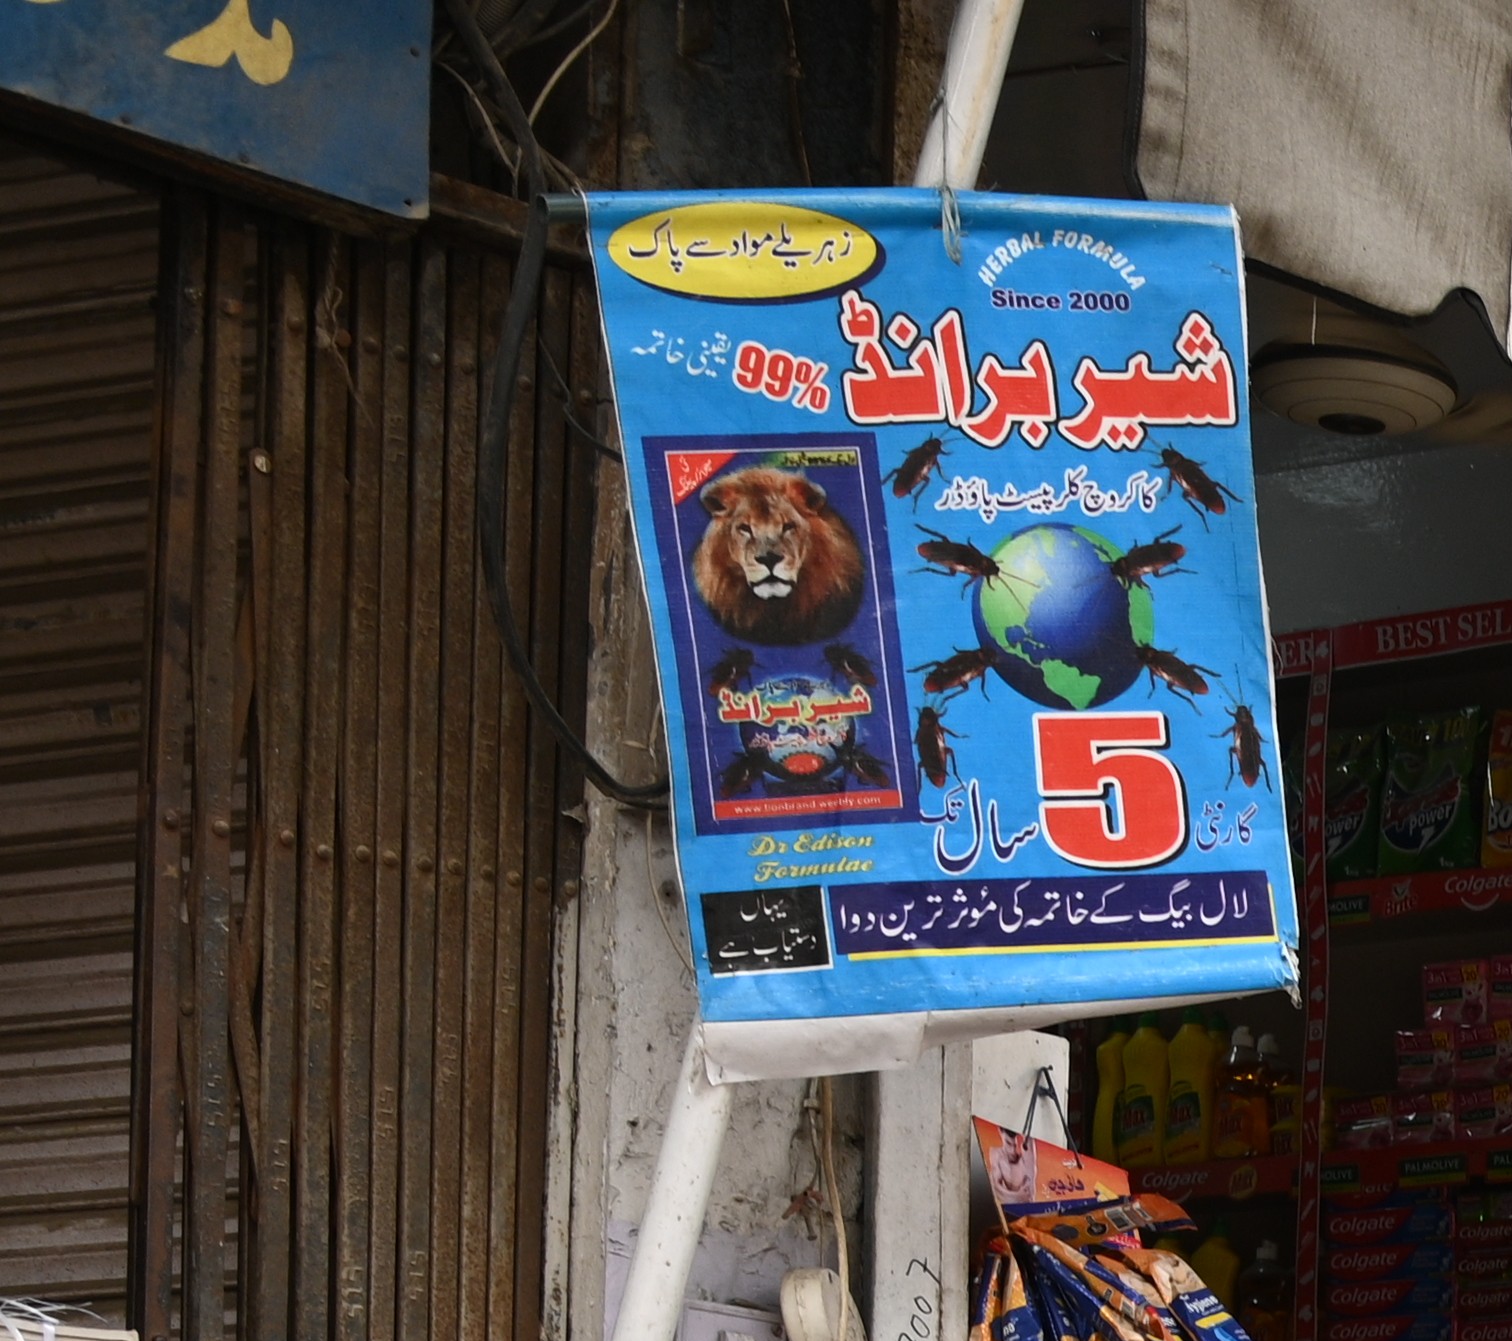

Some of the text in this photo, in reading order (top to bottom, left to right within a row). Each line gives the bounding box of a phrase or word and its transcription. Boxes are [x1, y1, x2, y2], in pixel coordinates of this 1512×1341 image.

[628, 217, 683, 273] پاک
[686, 239, 727, 257] سے
[978, 230, 1146, 291] HERBAL FORMULA
[991, 288, 1130, 312] Since 2000
[733, 340, 831, 414] 99%
[840, 288, 1238, 449] شیر برانڈ
[1375, 618, 1450, 653] BEST
[1033, 710, 1189, 869] 5
[747, 832, 874, 857] Dr Edison
[934, 778, 1040, 876] سال
[753, 856, 874, 883] Formulae
[739, 893, 787, 922] یہاں
[840, 903, 876, 932] دوا
[999, 881, 1031, 933] کی
[1024, 890, 1088, 930] خاتمہ
[1088, 883, 1133, 925] کے
[1138, 879, 1193, 929] بیگ
[1199, 879, 1248, 926] لال
[1329, 1216, 1395, 1234] Colgate
